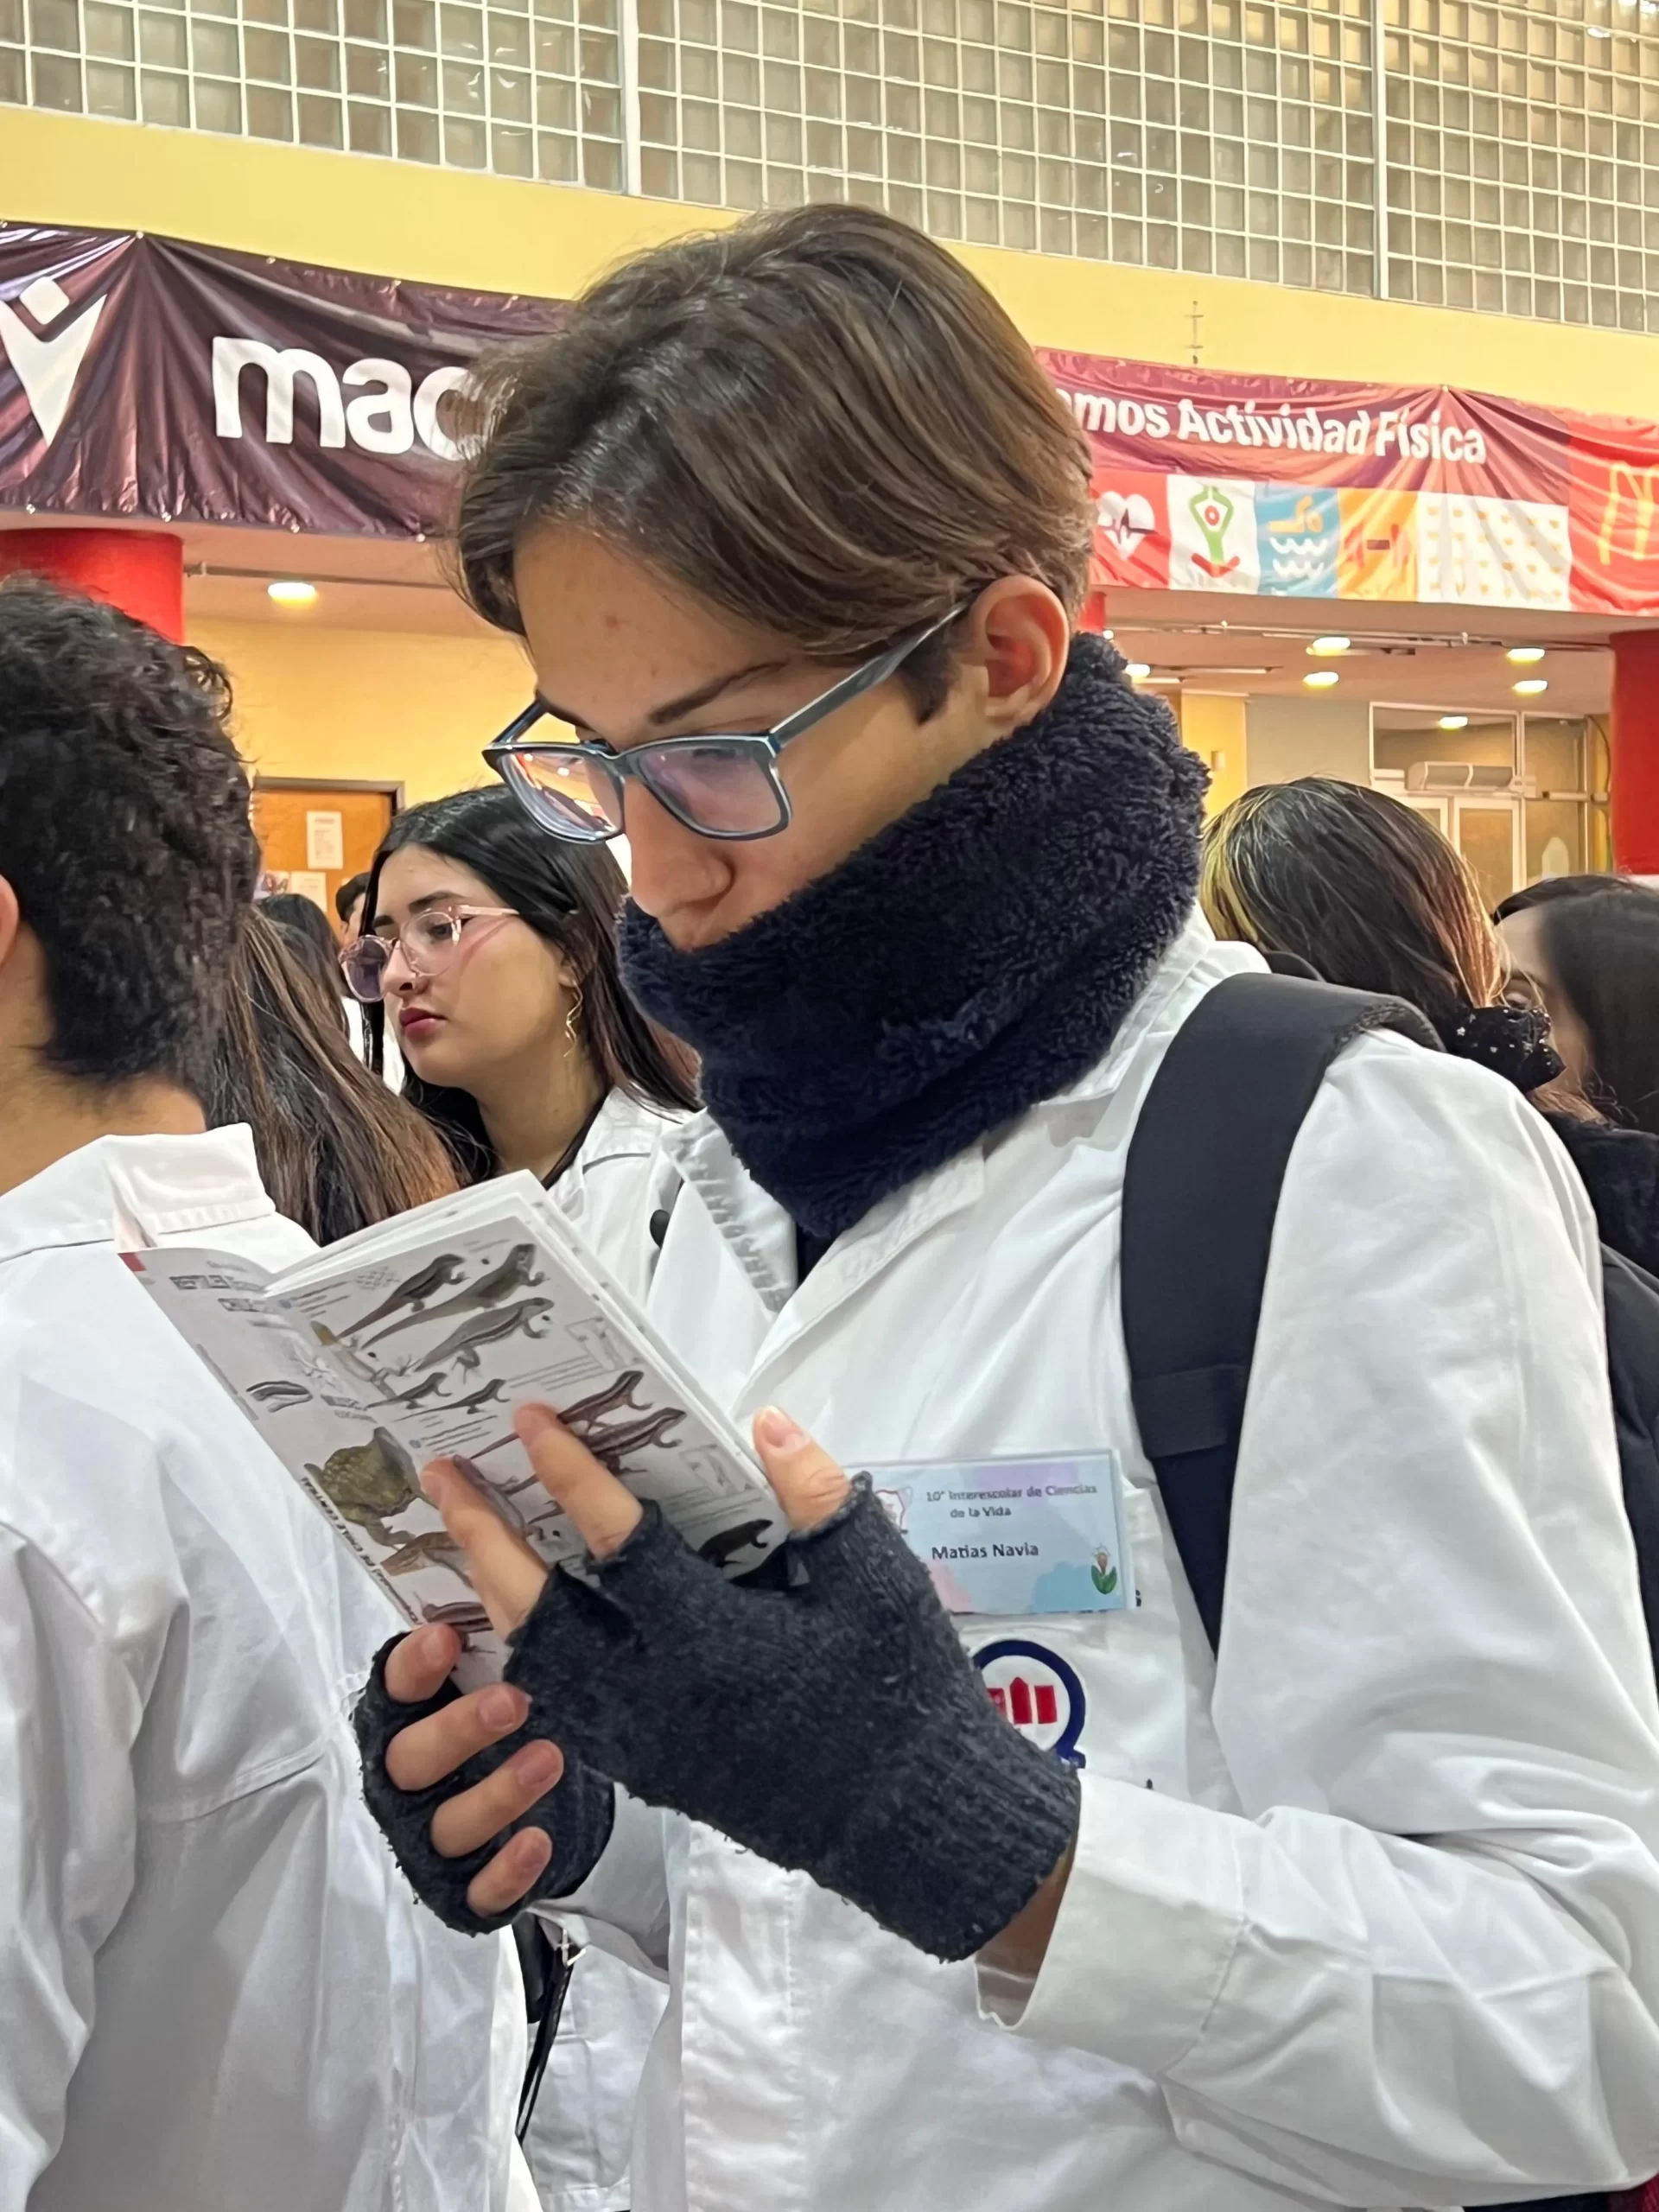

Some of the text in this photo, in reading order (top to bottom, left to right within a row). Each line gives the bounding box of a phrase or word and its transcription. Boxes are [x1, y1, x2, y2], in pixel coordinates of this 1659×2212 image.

[213, 335, 484, 461] mac
[1177, 398, 1371, 454] Actividad
[1375, 407, 1487, 464] Física
[948, 1487, 1023, 1501] Interescolar
[1026, 1485, 1042, 1497] de
[1045, 1484, 1097, 1497] Ciencias
[950, 1506, 1012, 1518] de la Vida
[992, 1542, 1039, 1557] Navia
